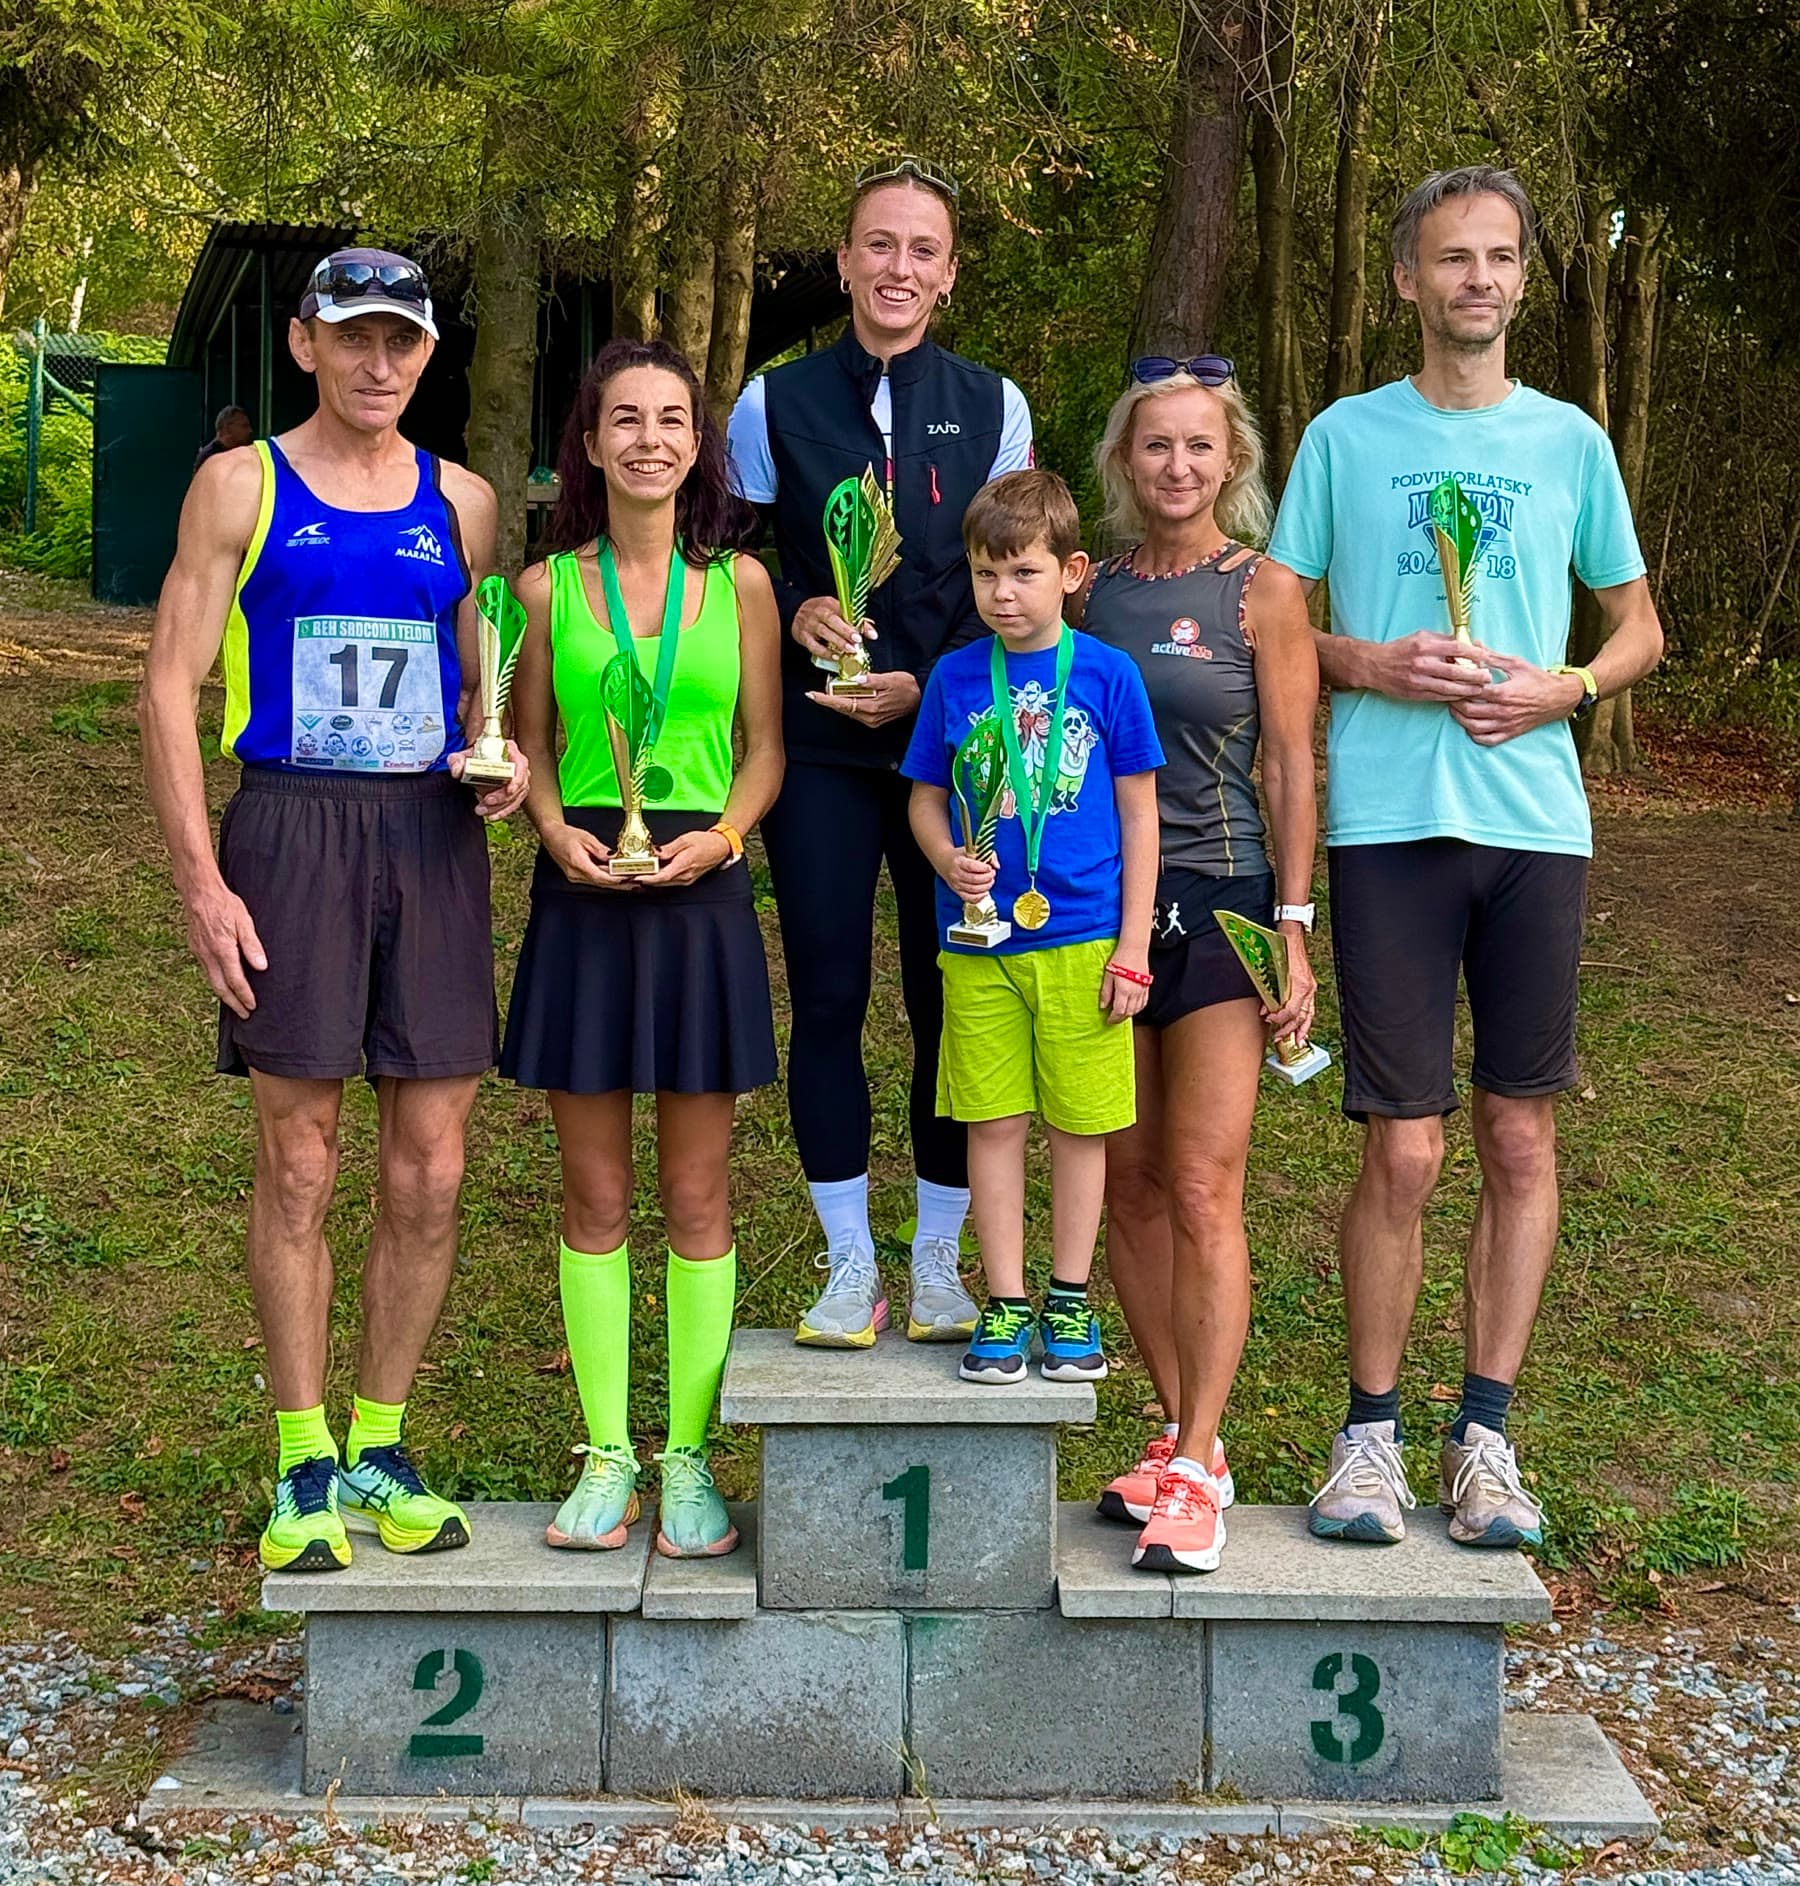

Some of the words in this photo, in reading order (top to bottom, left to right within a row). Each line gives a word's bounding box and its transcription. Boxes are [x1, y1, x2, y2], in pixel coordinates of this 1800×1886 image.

[1398, 551, 1425, 576] 20
[1486, 554, 1516, 580] 18
[312, 620, 338, 636] BEH
[397, 624, 433, 641] TELOM
[329, 644, 409, 708] 17
[882, 1465, 930, 1571] 1
[410, 1648, 484, 1757] 2
[1310, 1652, 1385, 1763] 3
